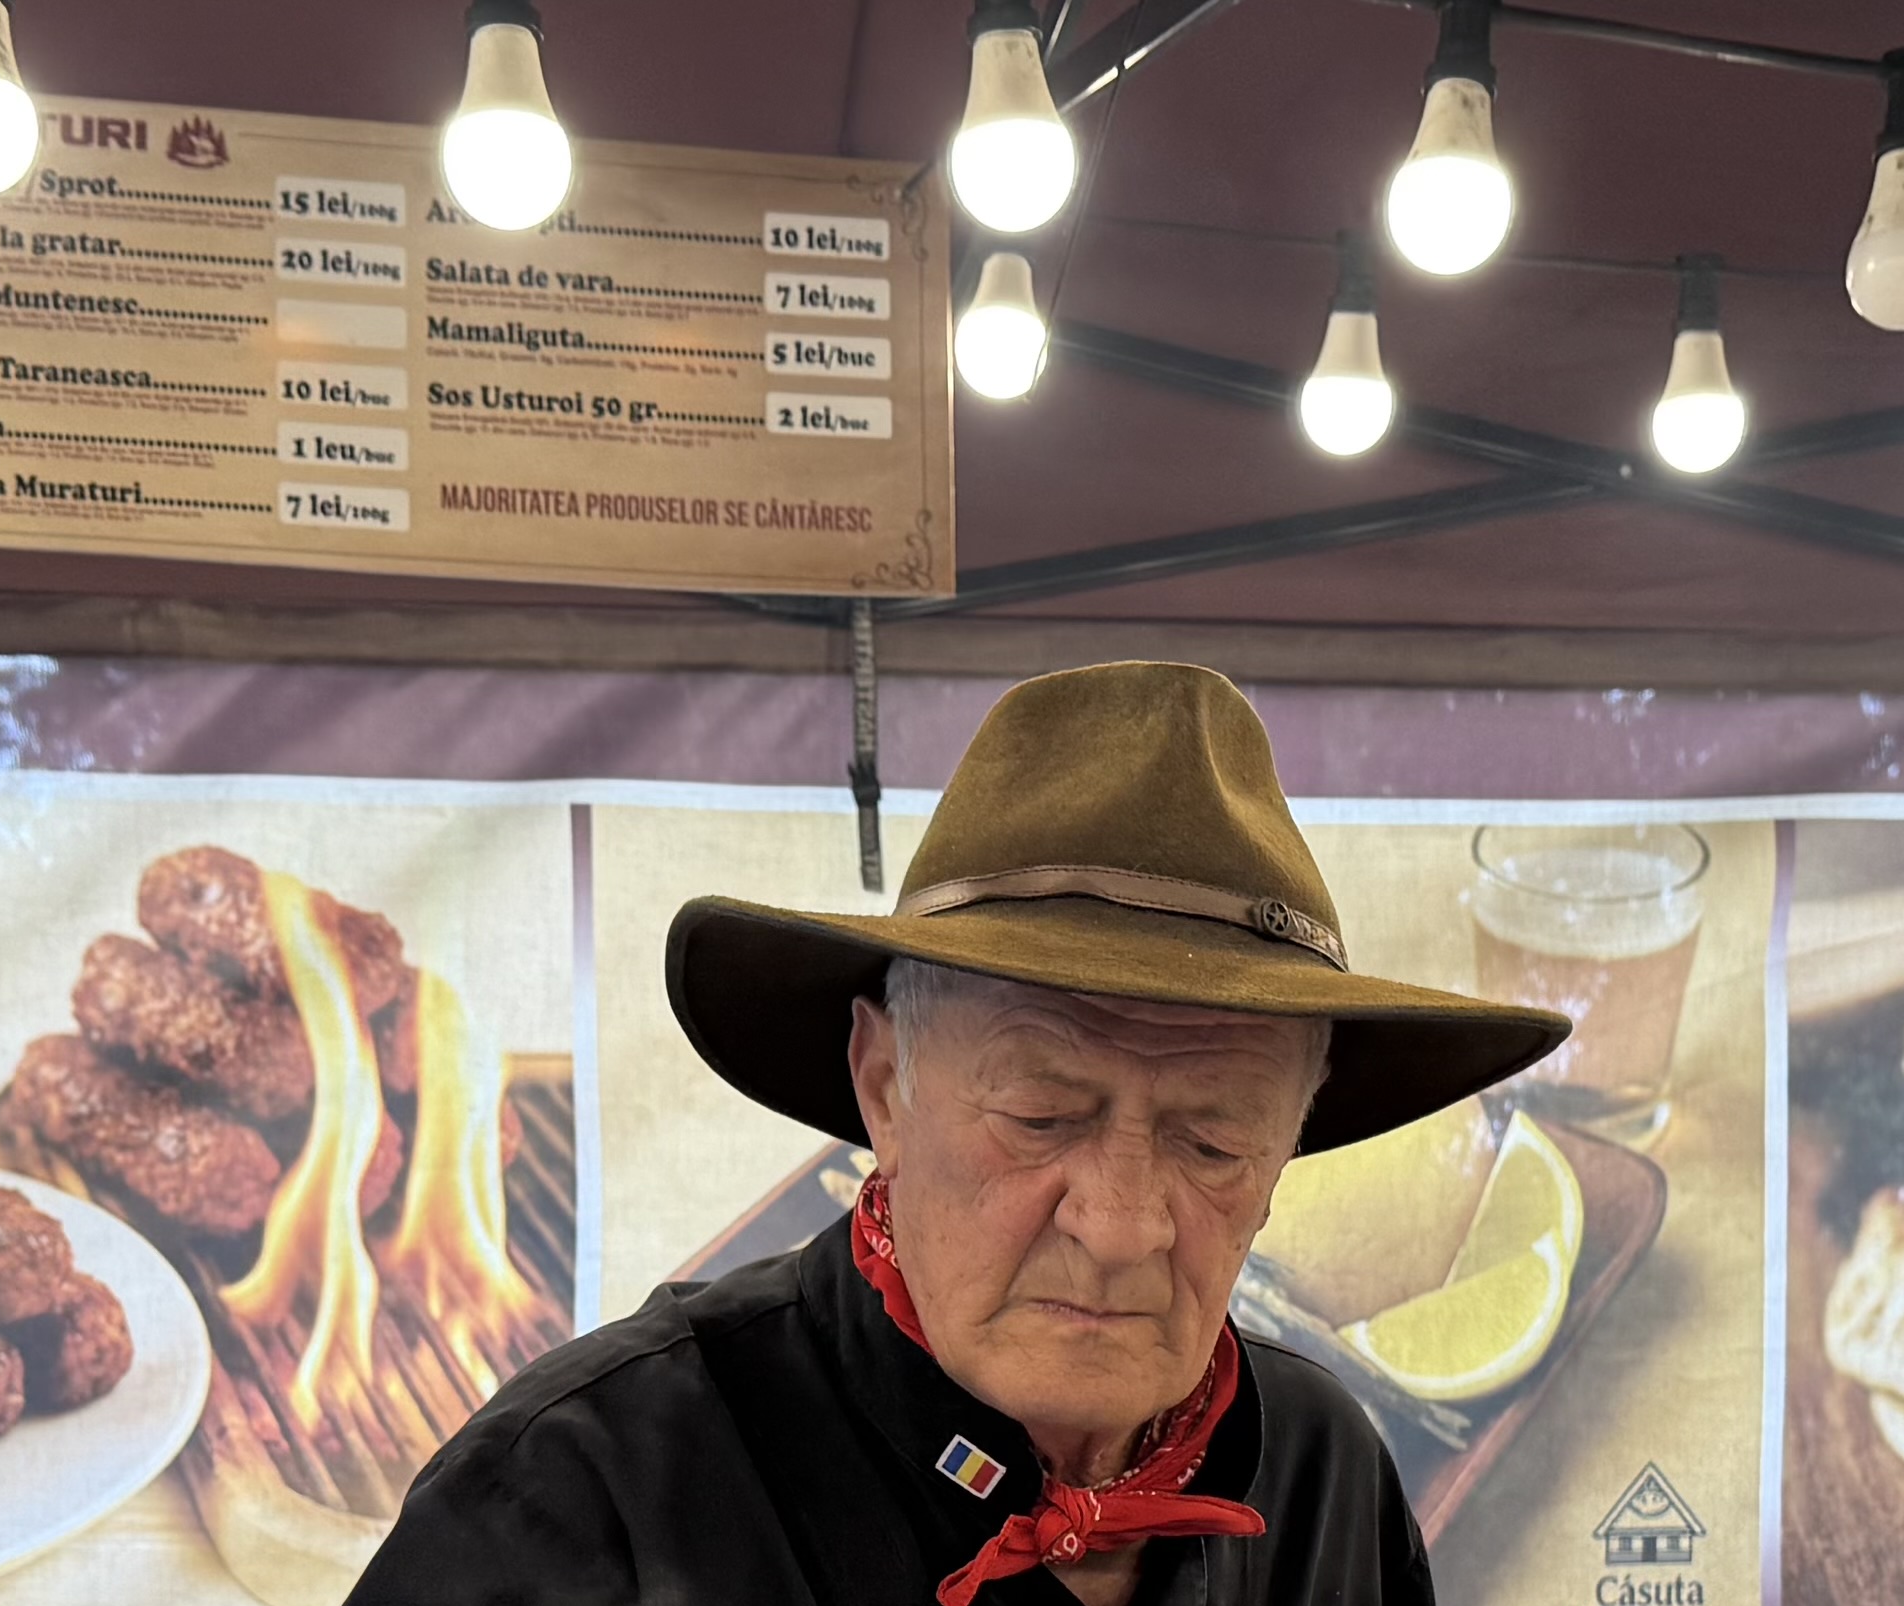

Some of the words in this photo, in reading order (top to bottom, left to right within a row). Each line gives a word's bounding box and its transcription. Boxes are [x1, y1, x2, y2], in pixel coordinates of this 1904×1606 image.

[281, 191, 309, 213] 15
[0, 224, 24, 248] la
[281, 250, 313, 270] 20
[770, 228, 798, 248] 10
[425, 258, 510, 288] Salata
[518, 264, 549, 289] de
[776, 285, 791, 308] 7
[773, 345, 787, 365] 5
[795, 342, 876, 370] lei/buc
[281, 379, 310, 398] 10
[428, 383, 472, 408] Sos
[481, 385, 583, 415] Usturoi
[592, 395, 622, 419] 50
[779, 409, 794, 427] 2
[292, 439, 307, 456] 1
[286, 497, 302, 517] 7
[440, 484, 580, 516] MAJORITATEA
[585, 492, 719, 525] PRODUSELOR
[725, 501, 749, 526] SE
